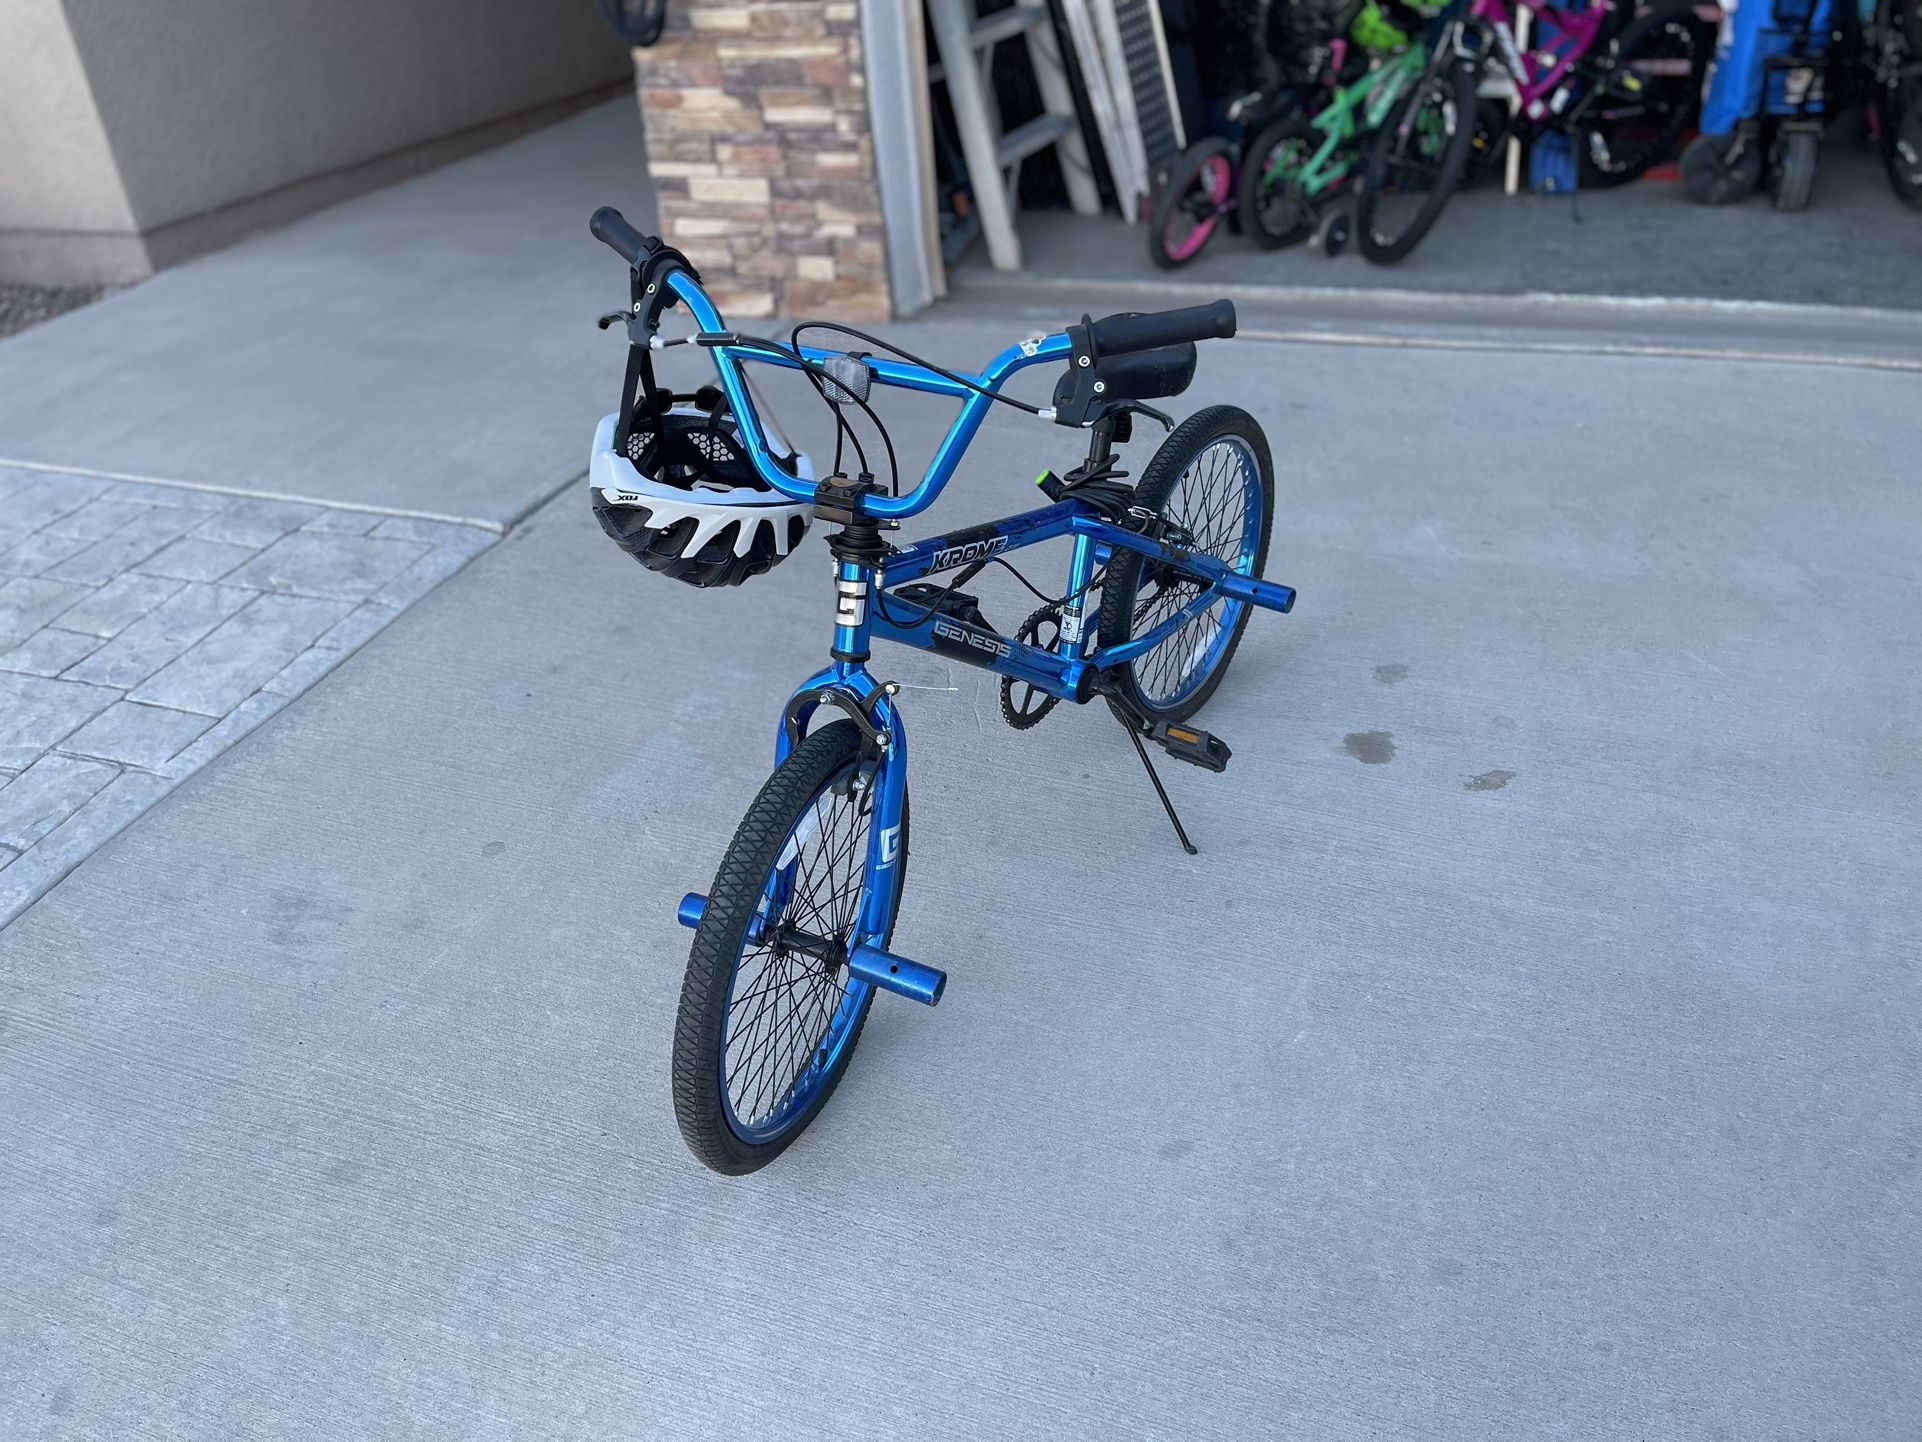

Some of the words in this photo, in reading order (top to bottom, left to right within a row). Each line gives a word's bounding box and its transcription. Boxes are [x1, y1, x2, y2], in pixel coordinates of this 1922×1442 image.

[613, 494, 639, 502] FOX
[928, 535, 1008, 575] KROME
[934, 620, 1012, 658] GENESIS
